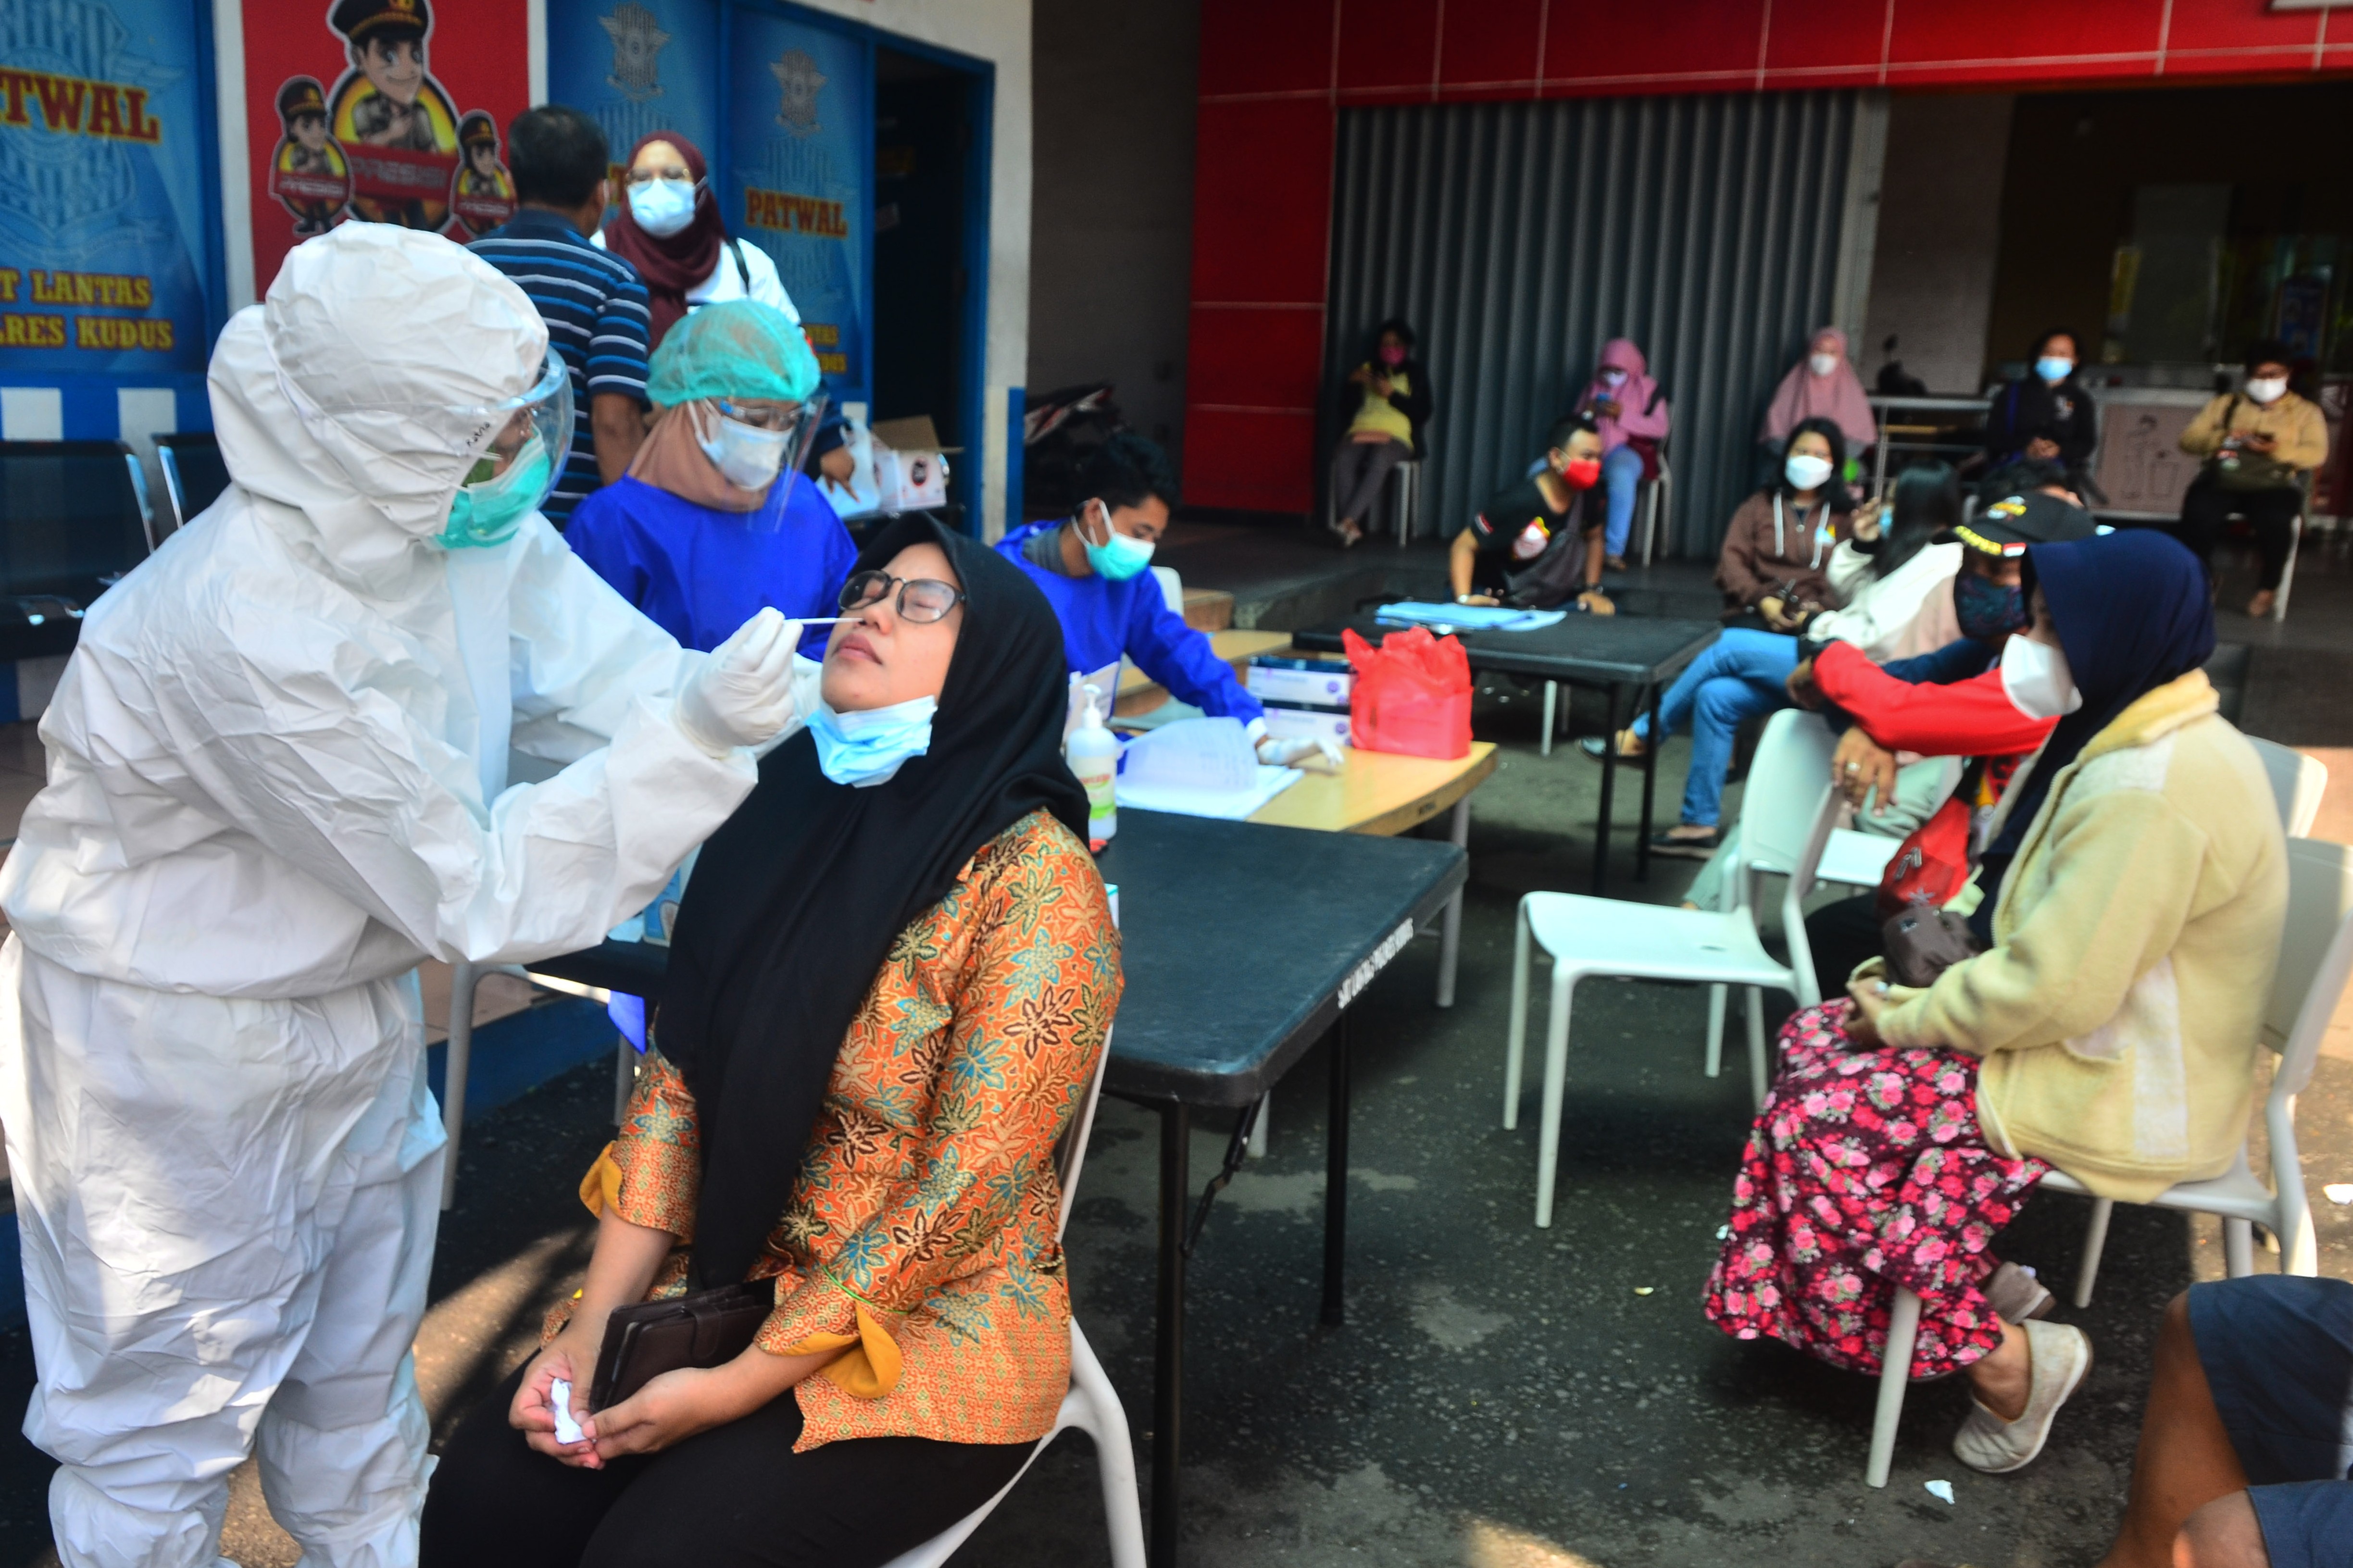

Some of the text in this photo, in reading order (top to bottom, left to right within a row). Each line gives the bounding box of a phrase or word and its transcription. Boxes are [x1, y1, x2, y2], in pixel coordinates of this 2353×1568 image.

[745, 187, 847, 238] PATWAL
[30, 269, 151, 308] LANTAS
[0, 312, 174, 351] RES KUDUS
